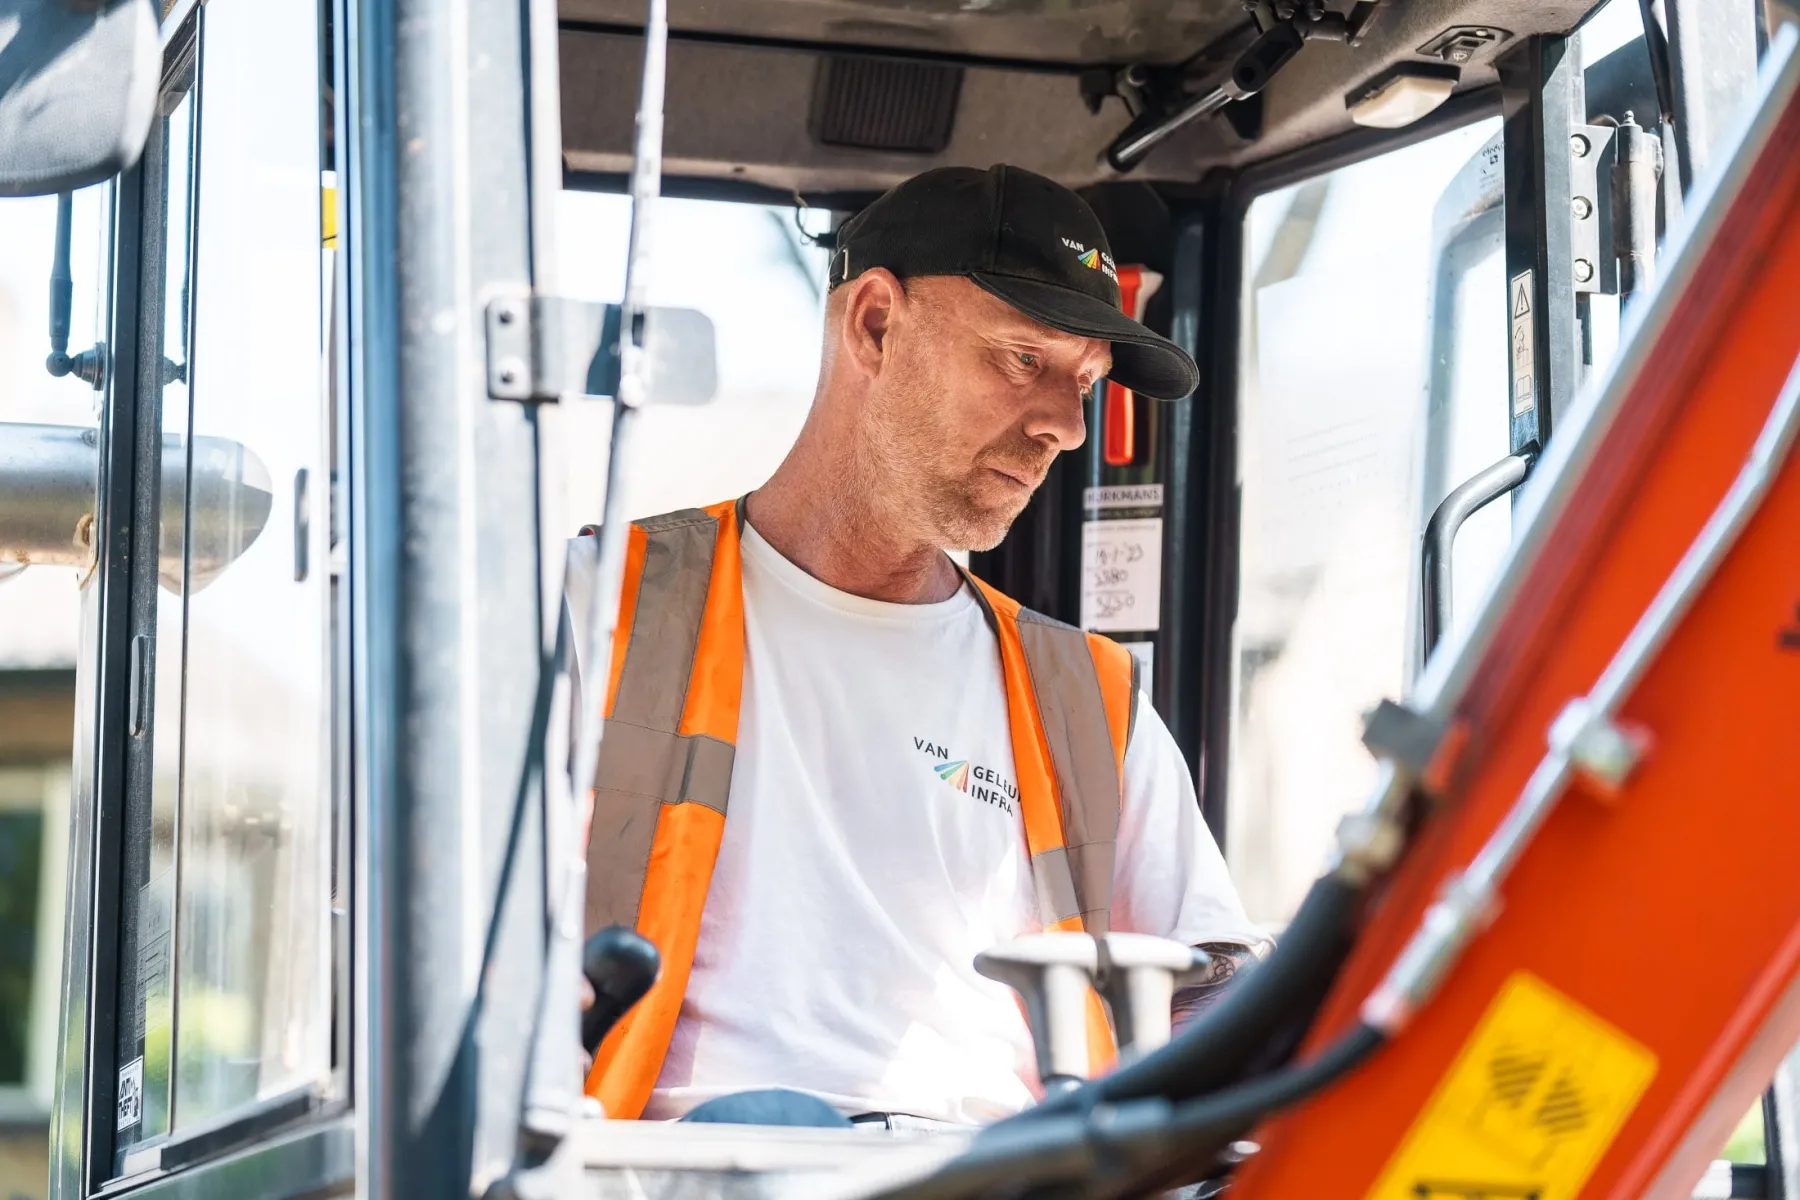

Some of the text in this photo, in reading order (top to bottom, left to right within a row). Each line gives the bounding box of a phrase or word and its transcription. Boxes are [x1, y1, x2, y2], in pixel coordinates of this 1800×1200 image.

[1061, 237, 1085, 252] VAN
[913, 736, 948, 760] VAN
[971, 784, 1013, 817] INFRA
